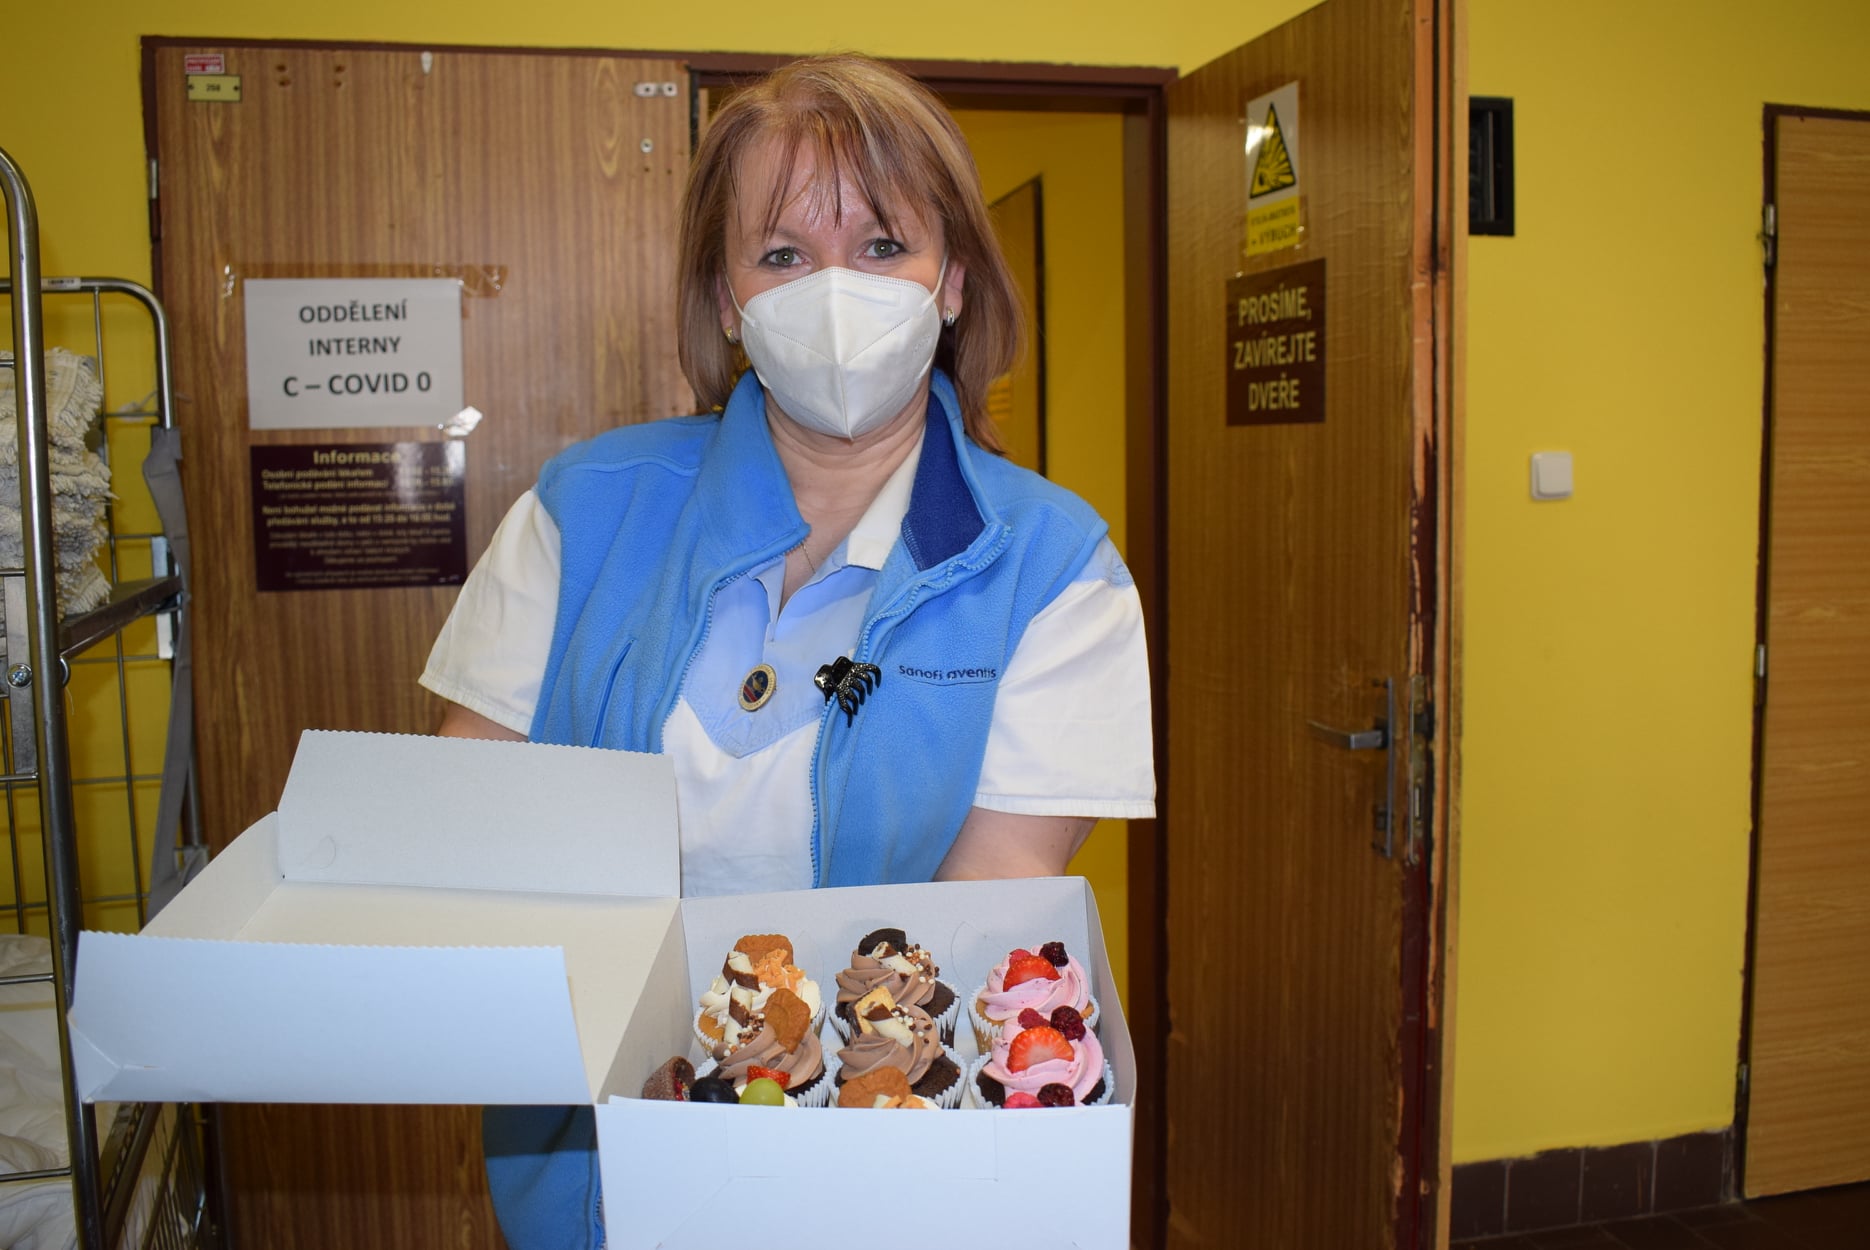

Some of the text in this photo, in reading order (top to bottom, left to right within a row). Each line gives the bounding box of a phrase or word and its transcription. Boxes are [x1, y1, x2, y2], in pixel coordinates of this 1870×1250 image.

[299, 299, 408, 324] ODDĚLENÍ
[1238, 283, 1312, 326] PROSÍME,
[309, 336, 401, 357] INTERNY
[1234, 331, 1316, 370] ZAVÍREJTE
[283, 376, 299, 397] C
[328, 372, 409, 395] COVID
[1248, 372, 1301, 411] DVEŘE
[313, 450, 401, 465] Informace
[898, 664, 997, 681] sanofi aventis
